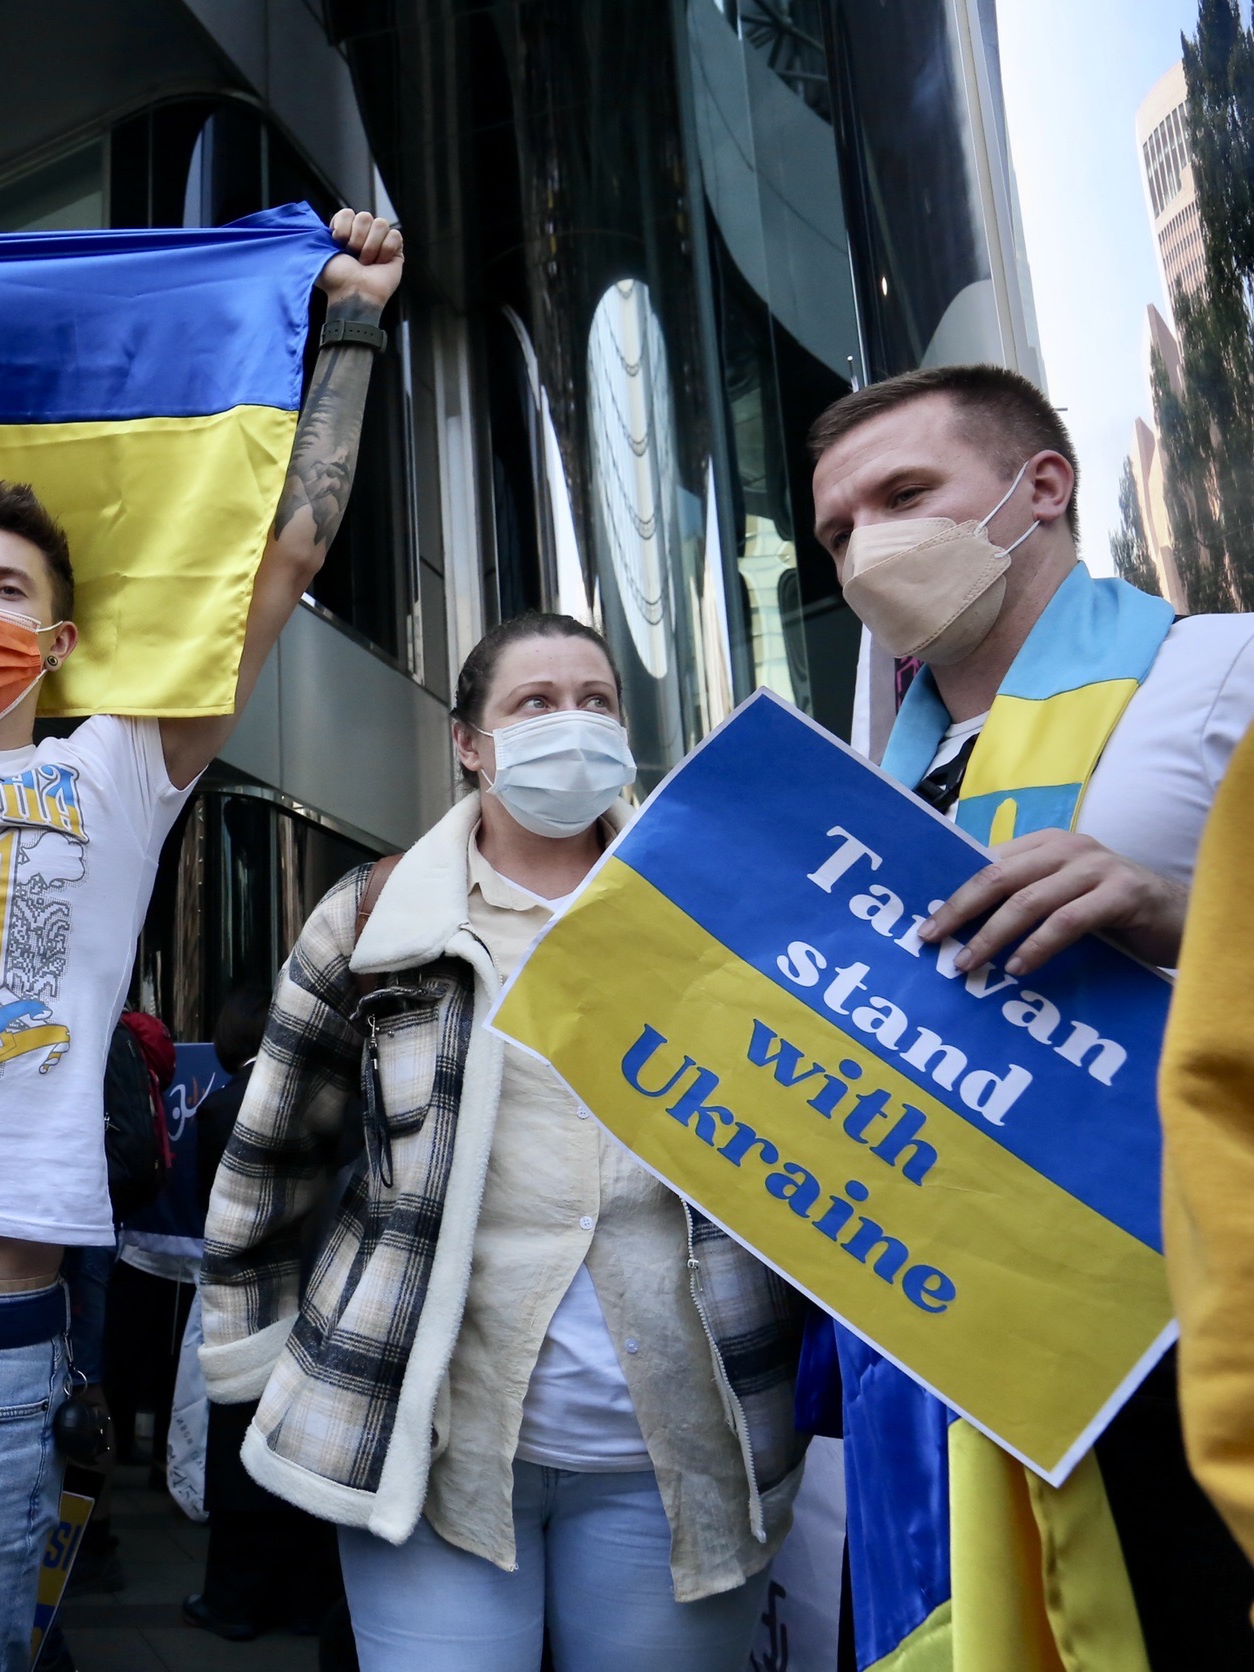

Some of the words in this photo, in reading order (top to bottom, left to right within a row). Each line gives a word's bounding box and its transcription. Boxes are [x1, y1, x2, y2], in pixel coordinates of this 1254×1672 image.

[775, 939, 1034, 1127] stand
[806, 825, 1130, 1087] Taiwan
[620, 1023, 957, 1315] Ukraine
[746, 1018, 940, 1188] with
